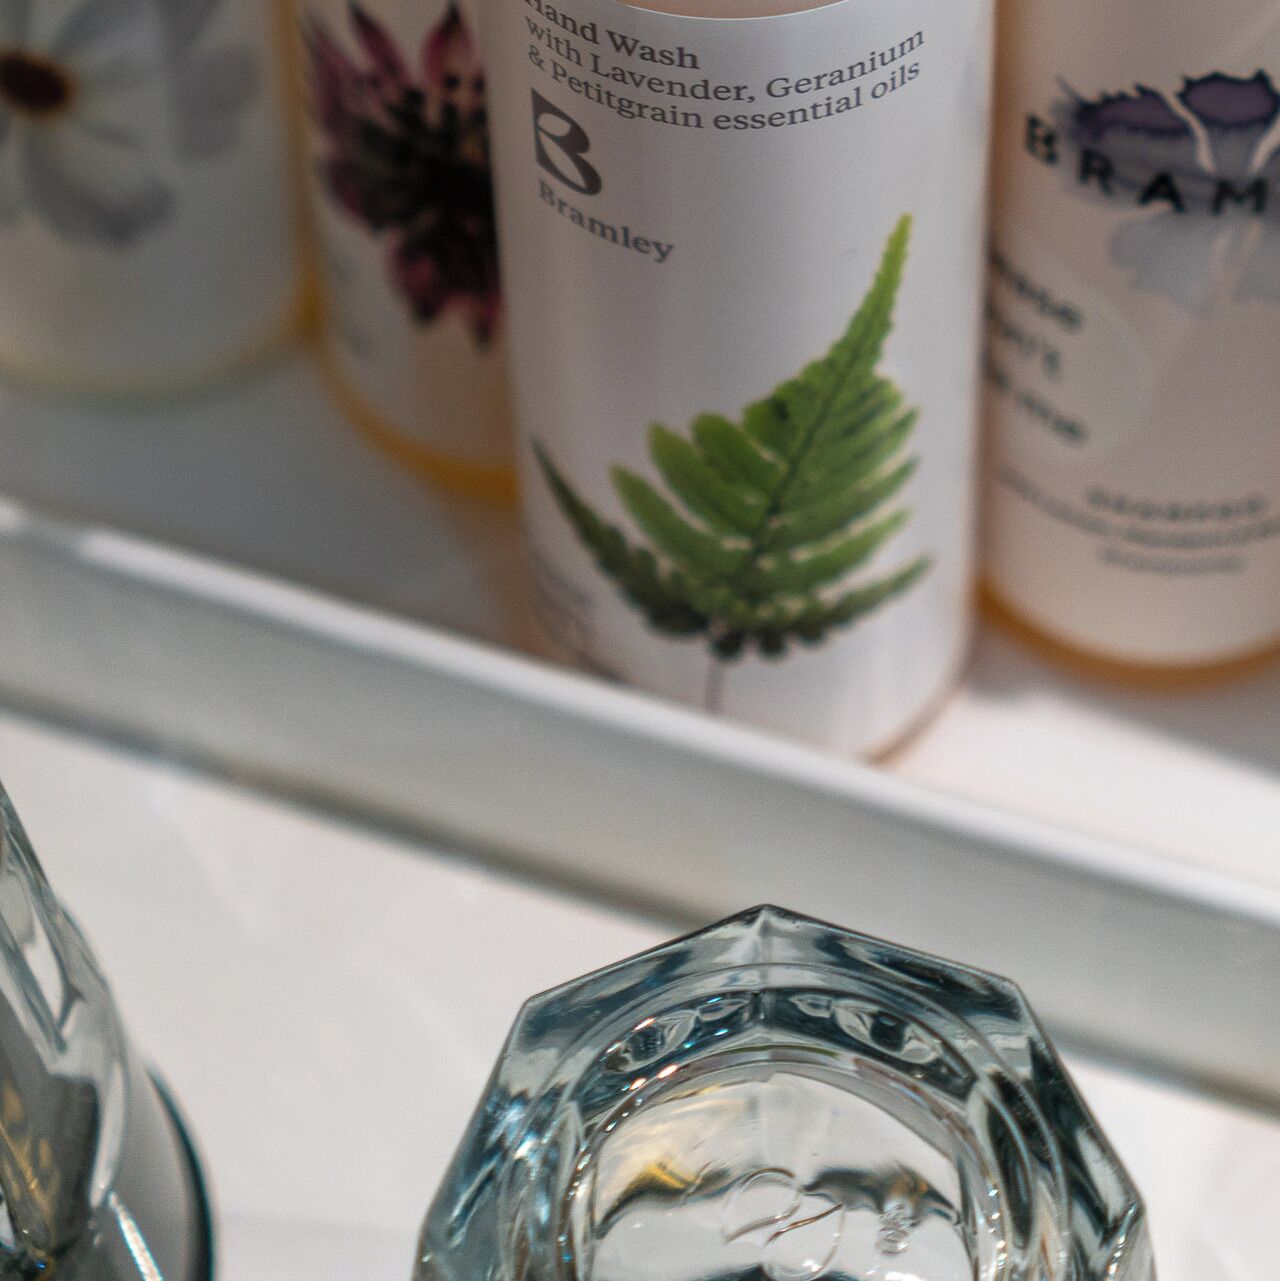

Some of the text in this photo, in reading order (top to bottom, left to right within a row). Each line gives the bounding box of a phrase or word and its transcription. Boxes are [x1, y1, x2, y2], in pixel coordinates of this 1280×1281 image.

[525, 17, 926, 104] with Lavender, Geranium
[527, 44, 921, 131] & Petitgrain essential oils
[606, 29, 701, 70] Wash
[538, 178, 676, 263] Bramley
